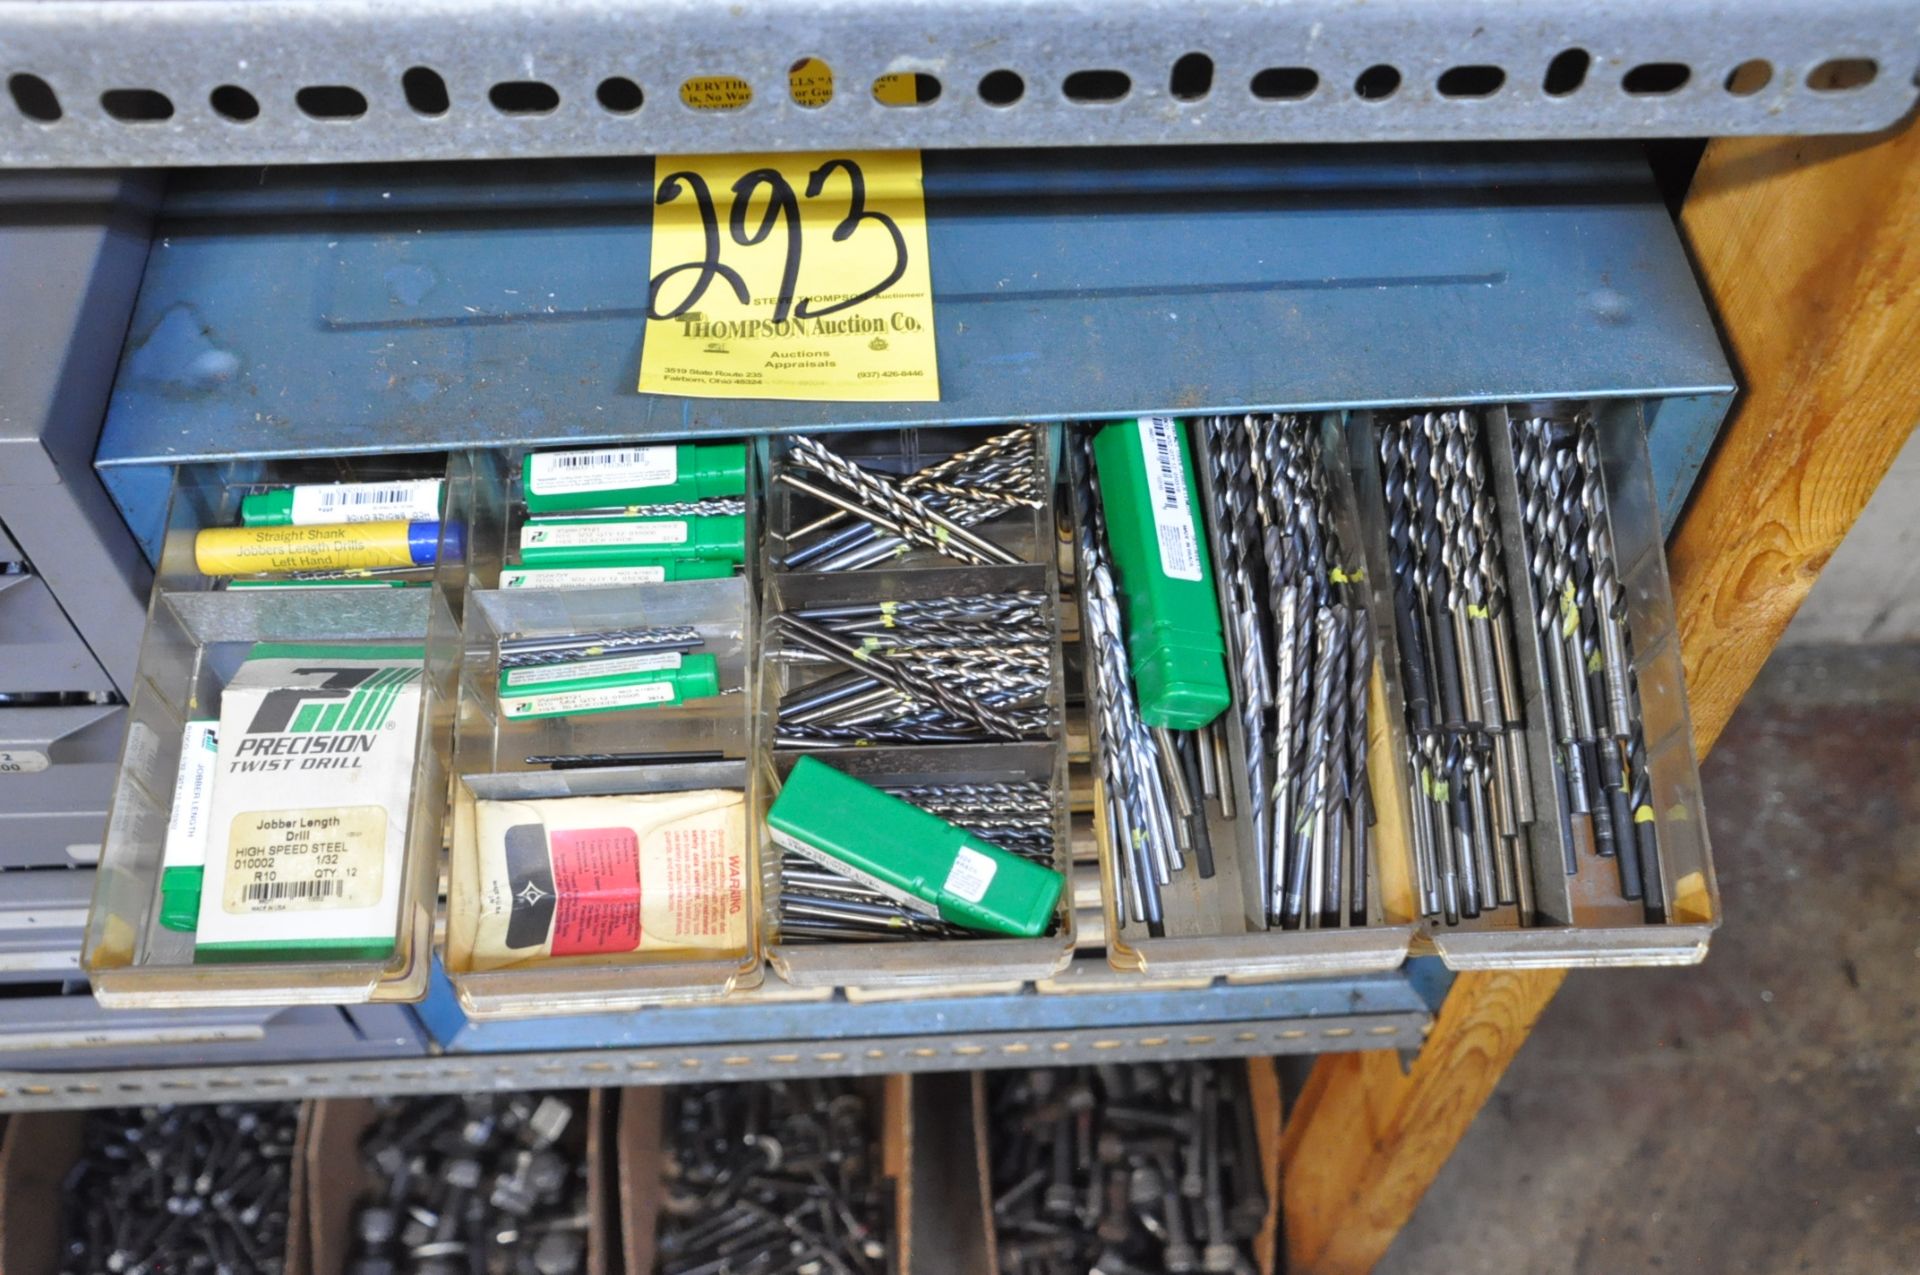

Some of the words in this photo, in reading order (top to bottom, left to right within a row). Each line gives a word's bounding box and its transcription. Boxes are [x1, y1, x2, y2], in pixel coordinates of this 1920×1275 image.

[705, 93, 722, 102] No
[648, 159, 908, 324] 293
[798, 293, 869, 304] THOMPSO
[678, 311, 806, 339] THOMPSON
[812, 314, 885, 335] Auction
[890, 311, 922, 332] Co.
[770, 351, 831, 359] Auctions
[689, 368, 713, 376] State
[764, 360, 837, 370] Appraisals
[708, 377, 732, 385] Ohio
[255, 530, 304, 544] Straight
[307, 528, 346, 541] Shank
[236, 545, 285, 557] Jobbers
[288, 543, 330, 555] Length
[333, 540, 365, 552] Drills
[271, 557, 298, 567] Left
[300, 555, 333, 567] Hand
[234, 734, 377, 757] PRECISION
[229, 759, 295, 773] TWIST
[300, 756, 363, 770] DRILL
[193, 763, 205, 800] JOBBER
[187, 801, 199, 838] LENGTH
[256, 818, 297, 830] Jobber
[300, 816, 341, 830] Length
[286, 830, 310, 842] Drill
[235, 846, 266, 857] HIGH
[268, 843, 308, 856] SPEED
[311, 841, 349, 854] STEEL
[234, 857, 275, 869] 010002
[315, 854, 339, 865] 1/32
[253, 871, 277, 882] R10
[314, 868, 336, 879] QTY
[346, 868, 357, 877] 12
